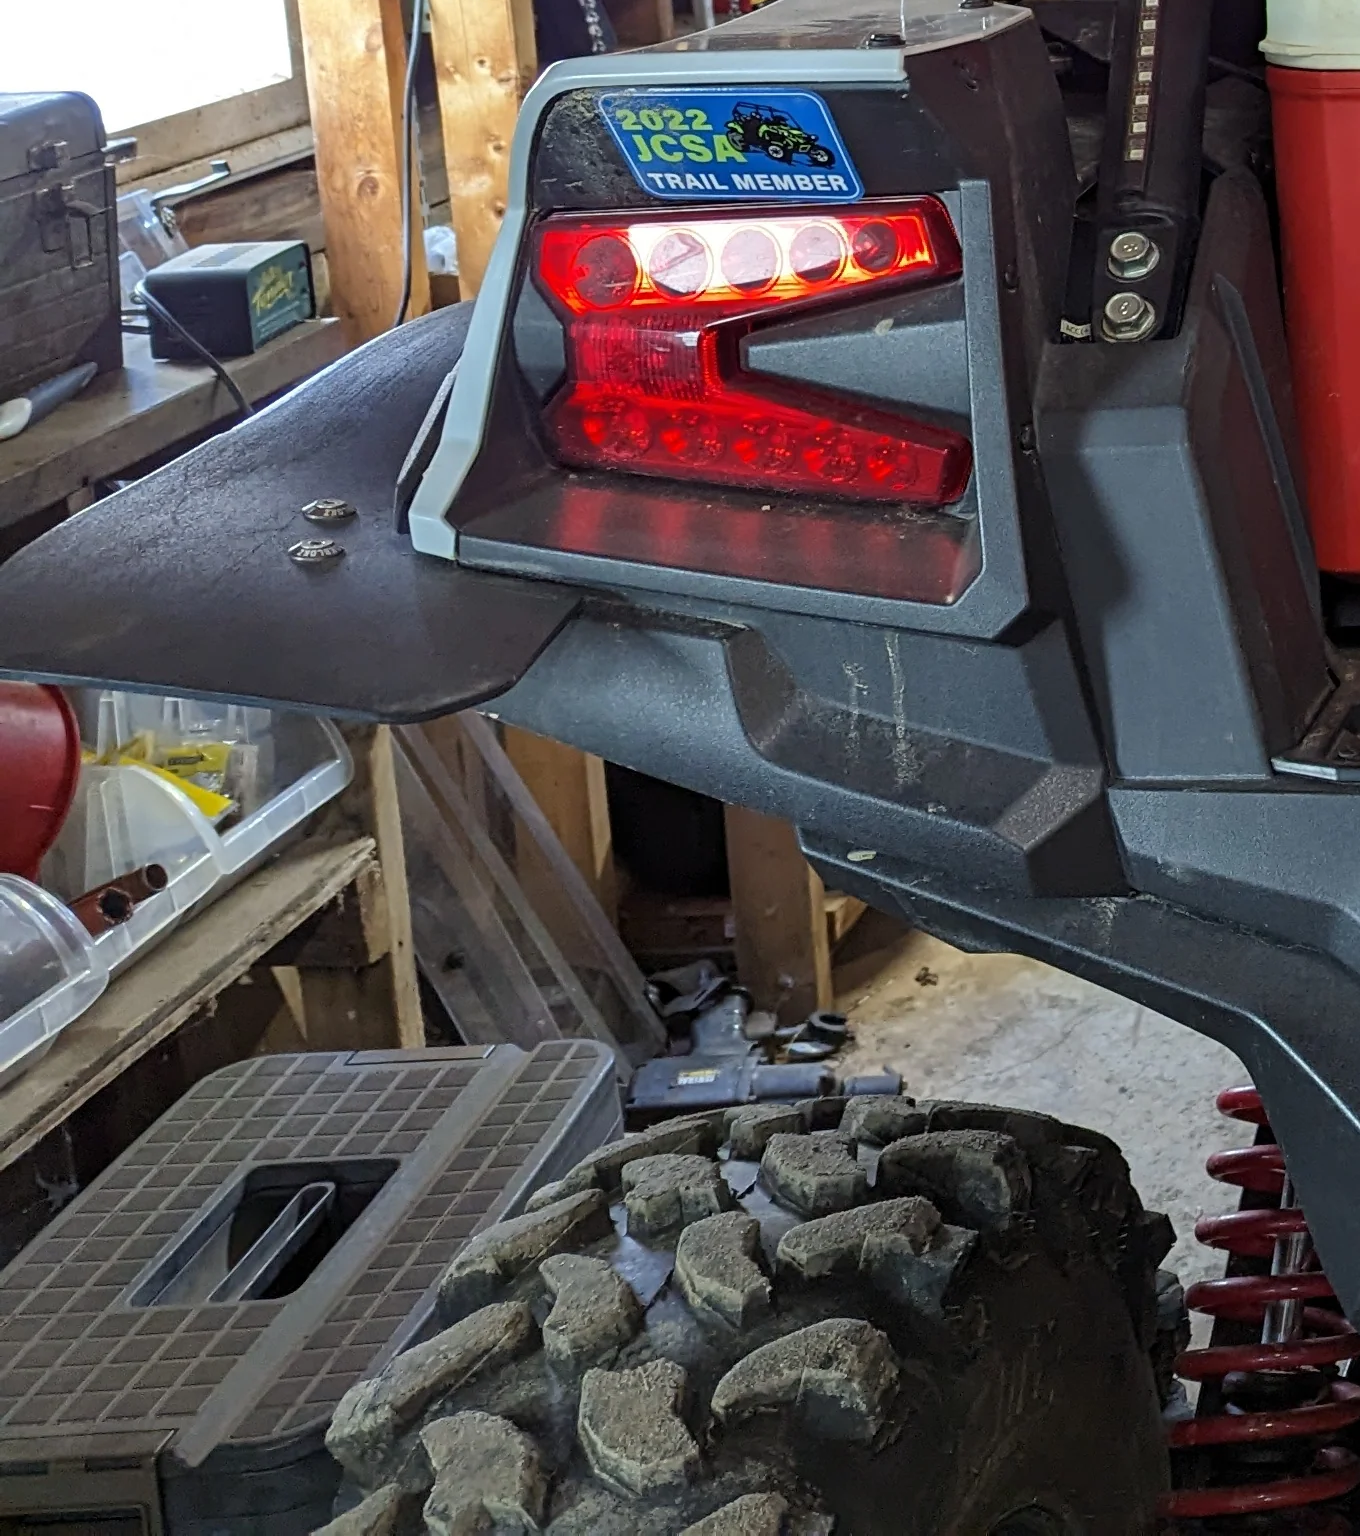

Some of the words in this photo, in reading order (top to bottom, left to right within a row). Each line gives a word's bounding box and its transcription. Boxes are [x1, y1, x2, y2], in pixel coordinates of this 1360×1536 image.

[615, 109, 713, 132] 2022
[633, 134, 748, 163] JCSA
[647, 173, 729, 191] TRAIL
[730, 173, 849, 192] MEMBER
